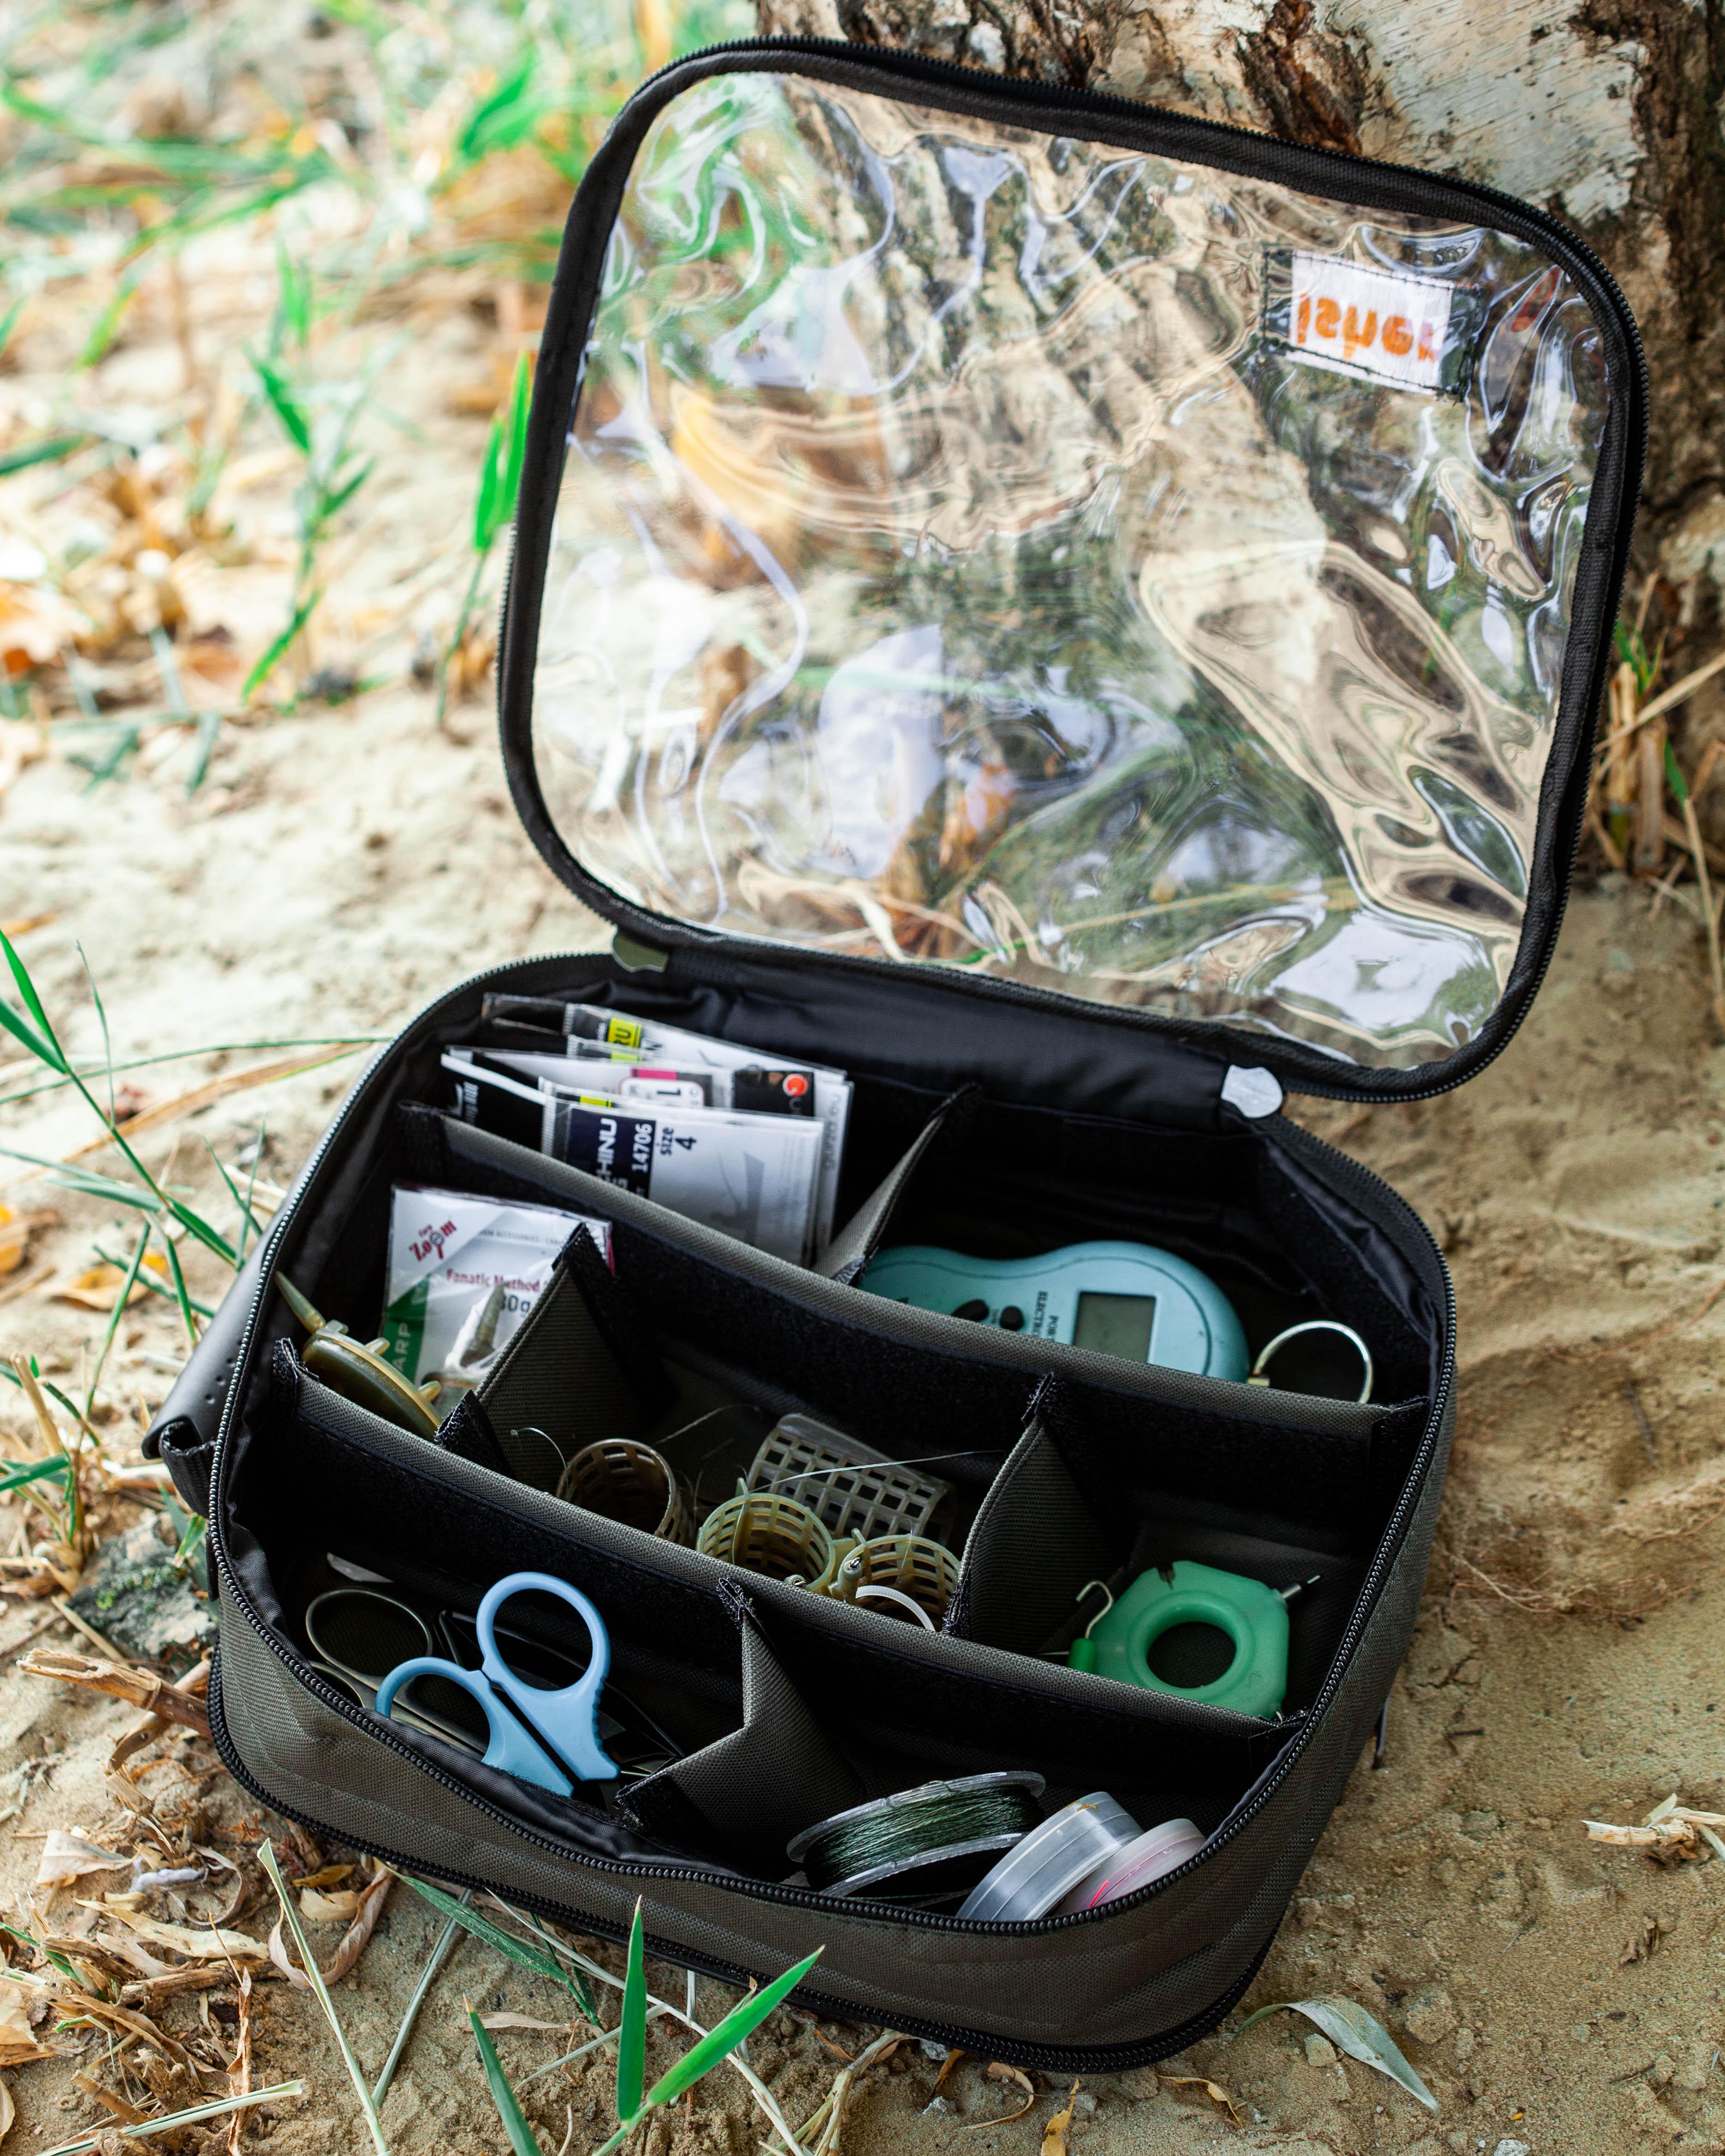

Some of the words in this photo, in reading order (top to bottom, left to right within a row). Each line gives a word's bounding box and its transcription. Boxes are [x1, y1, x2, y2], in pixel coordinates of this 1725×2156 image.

[596, 1117, 618, 1181] HINU
[631, 1123, 653, 1173] 14706
[656, 1127, 674, 1156] size
[675, 1137, 697, 1151] 4
[446, 1268, 490, 1287] Fanatic
[494, 1275, 540, 1292] Method
[1046, 1315, 1059, 1340] POR
[392, 1322, 411, 1373] ARP
